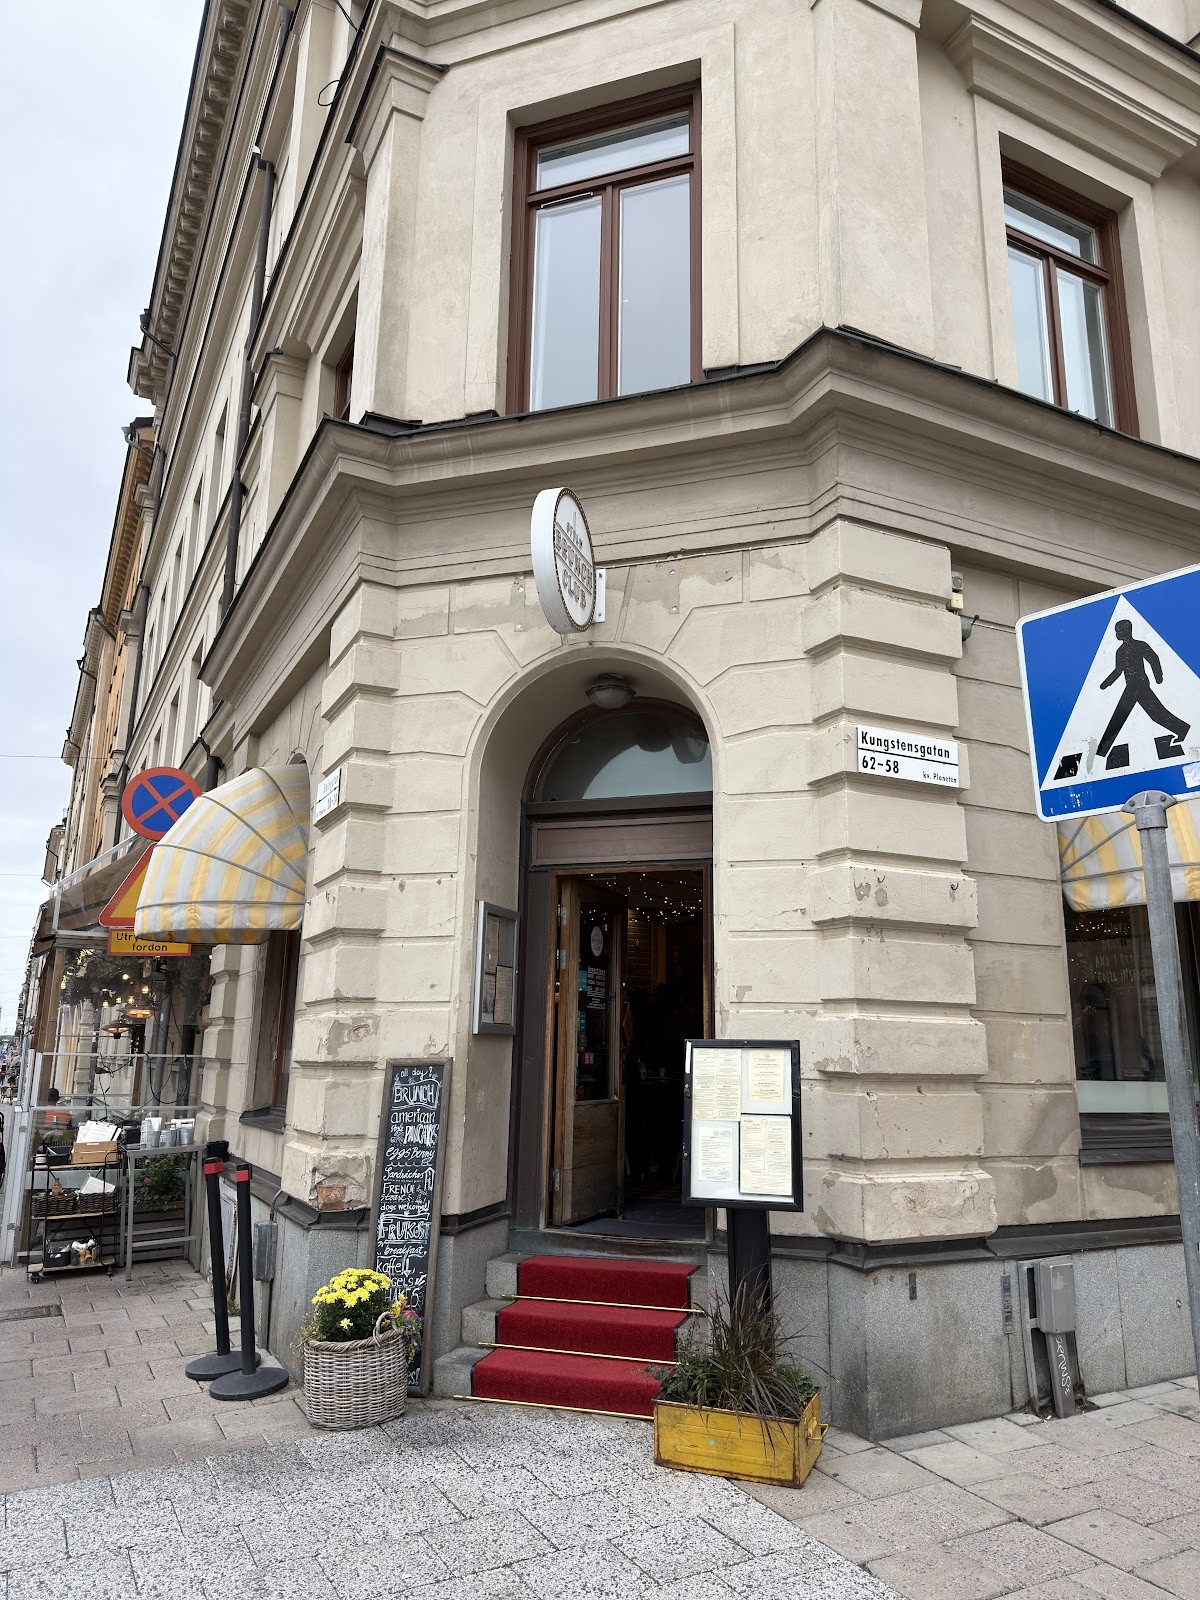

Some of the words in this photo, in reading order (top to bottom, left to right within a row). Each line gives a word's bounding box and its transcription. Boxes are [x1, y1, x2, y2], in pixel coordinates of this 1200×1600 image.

[556, 528, 593, 590] BRUNCH
[562, 569, 587, 609] CLUB
[861, 730, 950, 759] Kungstensgatan
[862, 755, 900, 774] 62-58
[132, 943, 168, 951] fordon
[394, 1084, 435, 1104] BRUNCH
[390, 1108, 436, 1123] american
[386, 1146, 411, 1161] eggs
[377, 1217, 432, 1241] FRUKOST
[384, 1245, 425, 1258] breakfast
